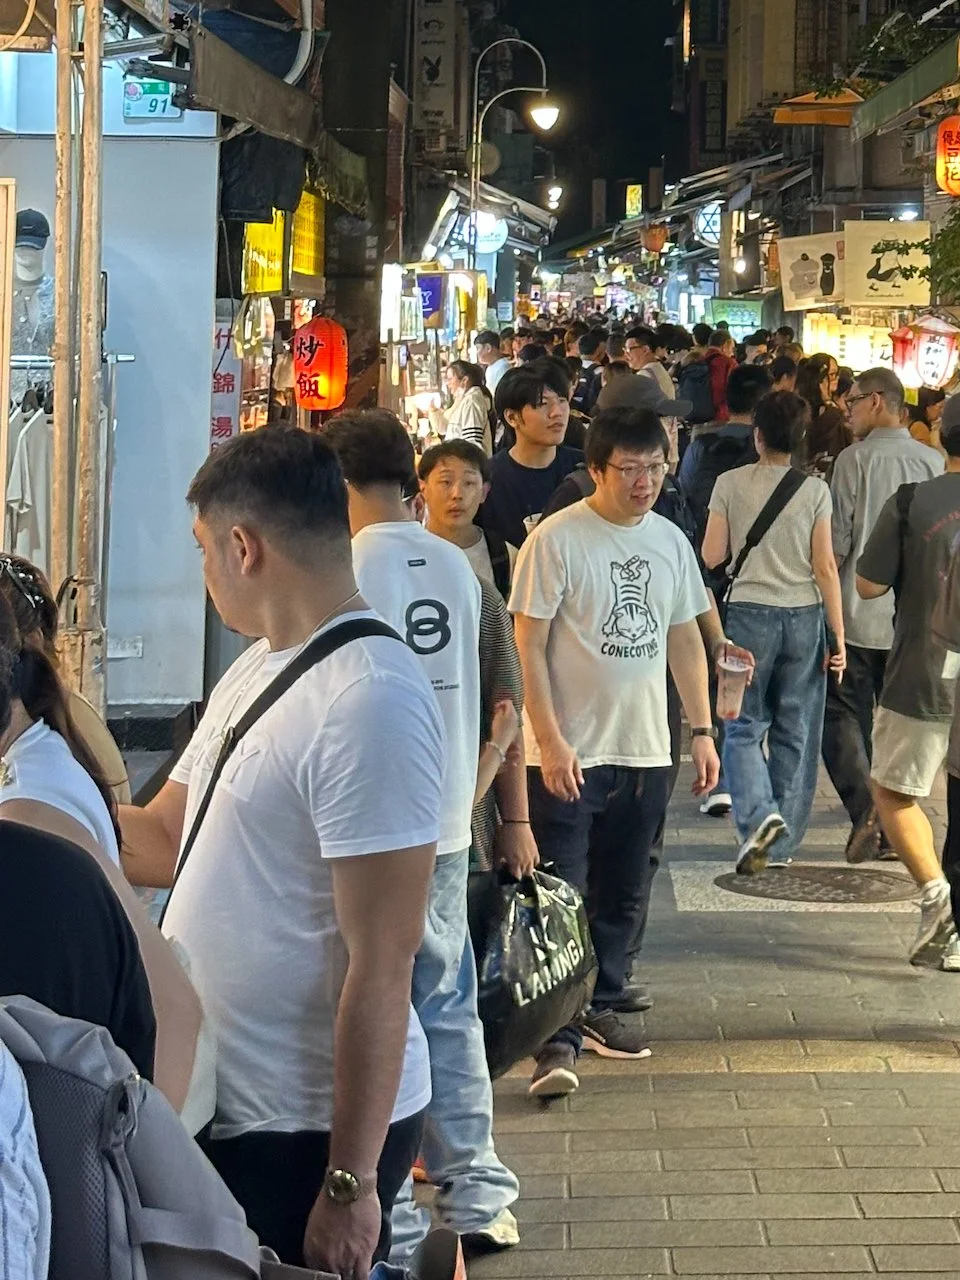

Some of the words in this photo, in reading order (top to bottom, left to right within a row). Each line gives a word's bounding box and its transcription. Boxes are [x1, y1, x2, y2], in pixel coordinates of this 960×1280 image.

[148, 98, 168, 113] 91
[211, 327, 235, 439] 什錦湯
[296, 335, 326, 400] 炒飯
